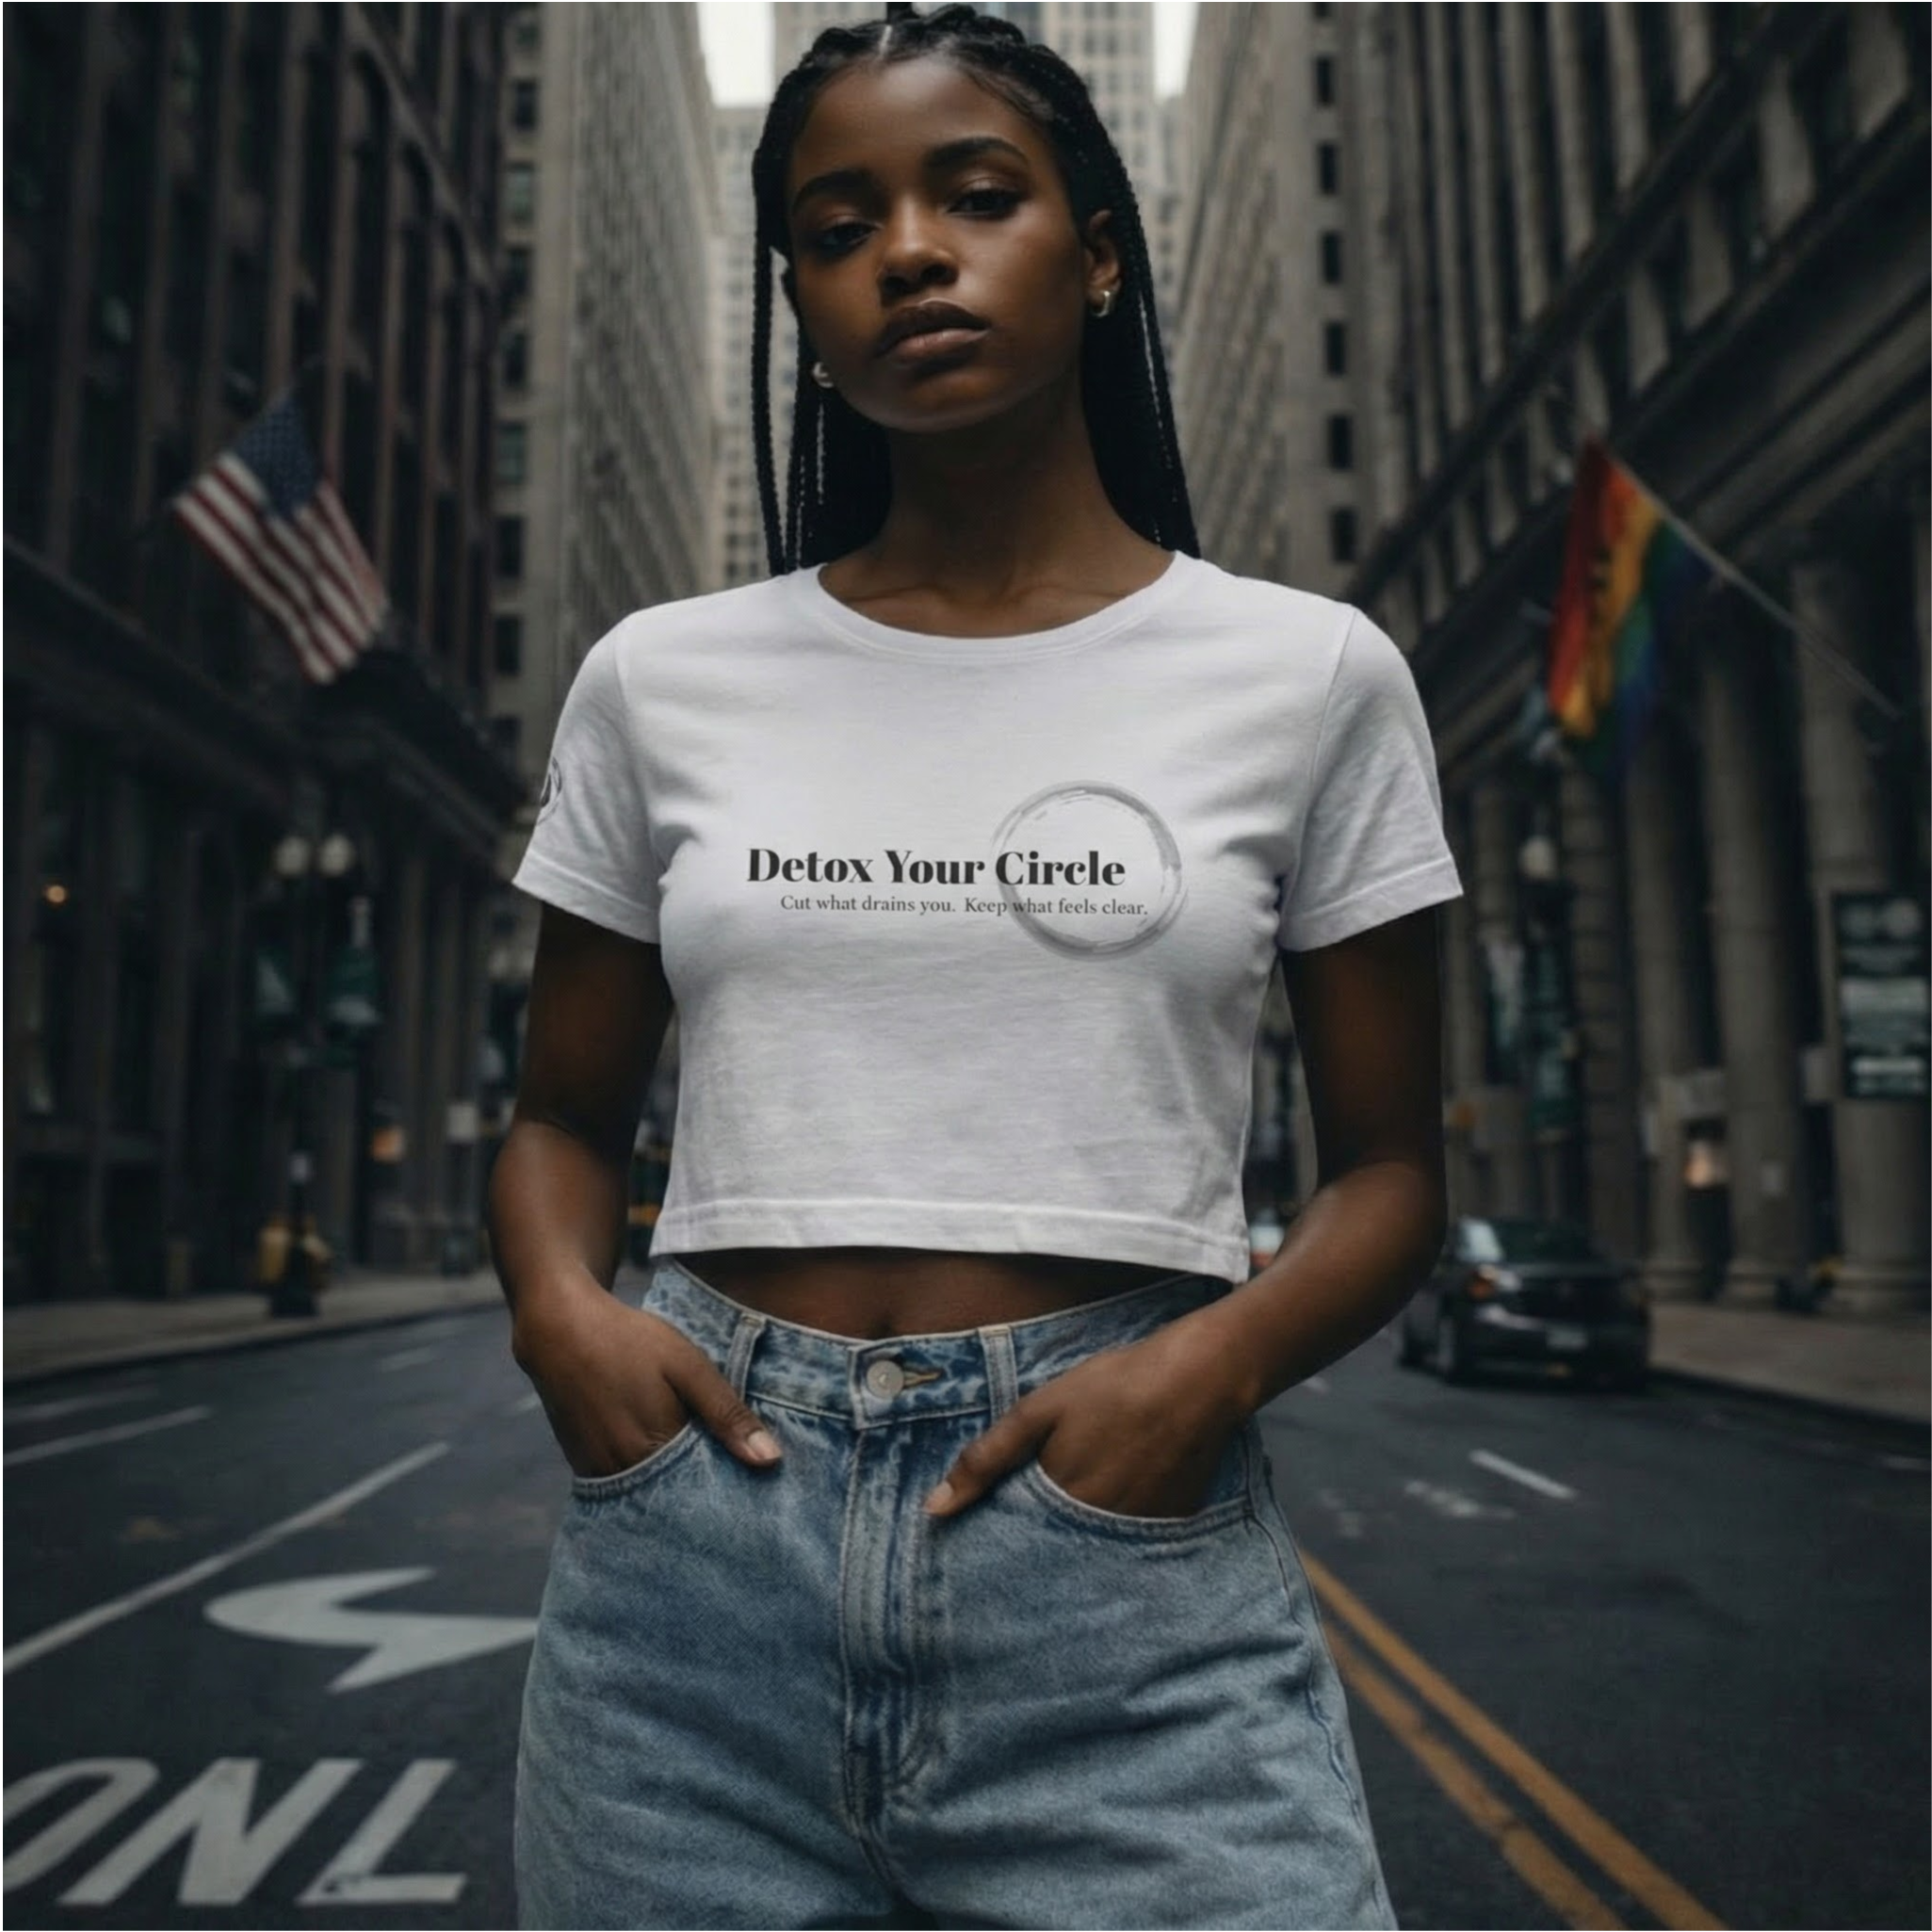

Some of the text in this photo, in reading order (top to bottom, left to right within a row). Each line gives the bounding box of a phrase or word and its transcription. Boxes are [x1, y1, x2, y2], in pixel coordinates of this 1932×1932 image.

[747, 848, 1127, 886] Detox Your Circle
[780, 894, 1149, 917] Cut what drains you. Keep what feels clear.
